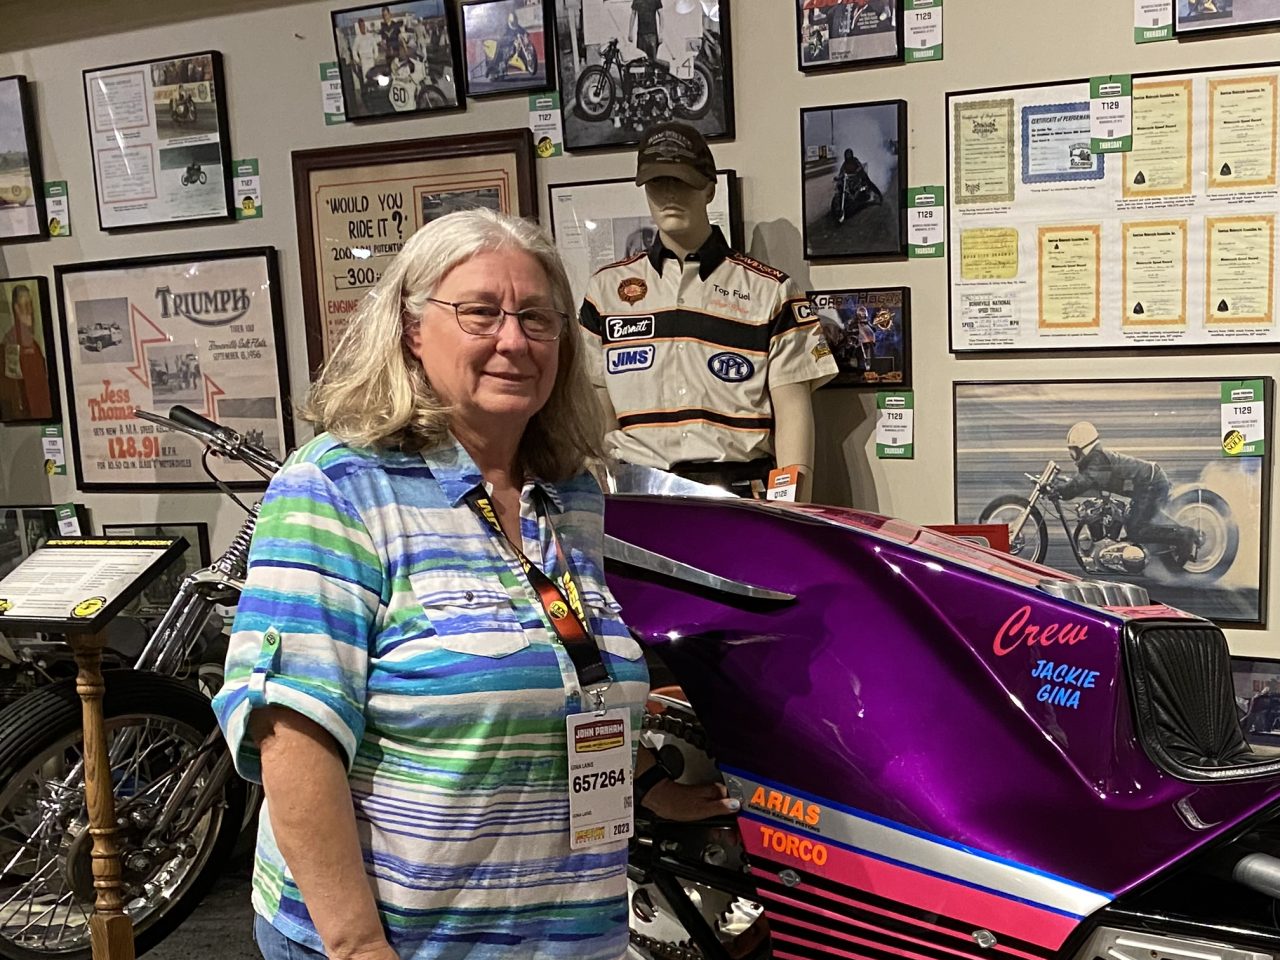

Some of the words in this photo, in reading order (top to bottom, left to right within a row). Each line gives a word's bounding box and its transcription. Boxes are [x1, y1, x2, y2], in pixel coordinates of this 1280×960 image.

[392, 86, 407, 104] 60
[1101, 102, 1120, 110] T129
[378, 192, 403, 212] YOU
[348, 220, 374, 240] RIDE
[378, 218, 388, 237] IT
[155, 285, 250, 319] TRIUMPH
[713, 284, 730, 297] Top
[733, 289, 750, 301] Fuel
[612, 350, 649, 368] JIMS
[100, 379, 130, 404] Jess
[1234, 407, 1252, 415] T129
[108, 436, 160, 459] 128.91
[993, 605, 1089, 656] Crew
[1030, 660, 1100, 690] JACKIE
[1036, 683, 1082, 709] GINA
[575, 727, 594, 739] JOHN
[595, 724, 623, 736] PARHAM
[573, 768, 625, 794] 657264
[751, 786, 820, 825] ARIAS
[614, 823, 630, 835] 2023
[760, 826, 827, 865] TORCO
